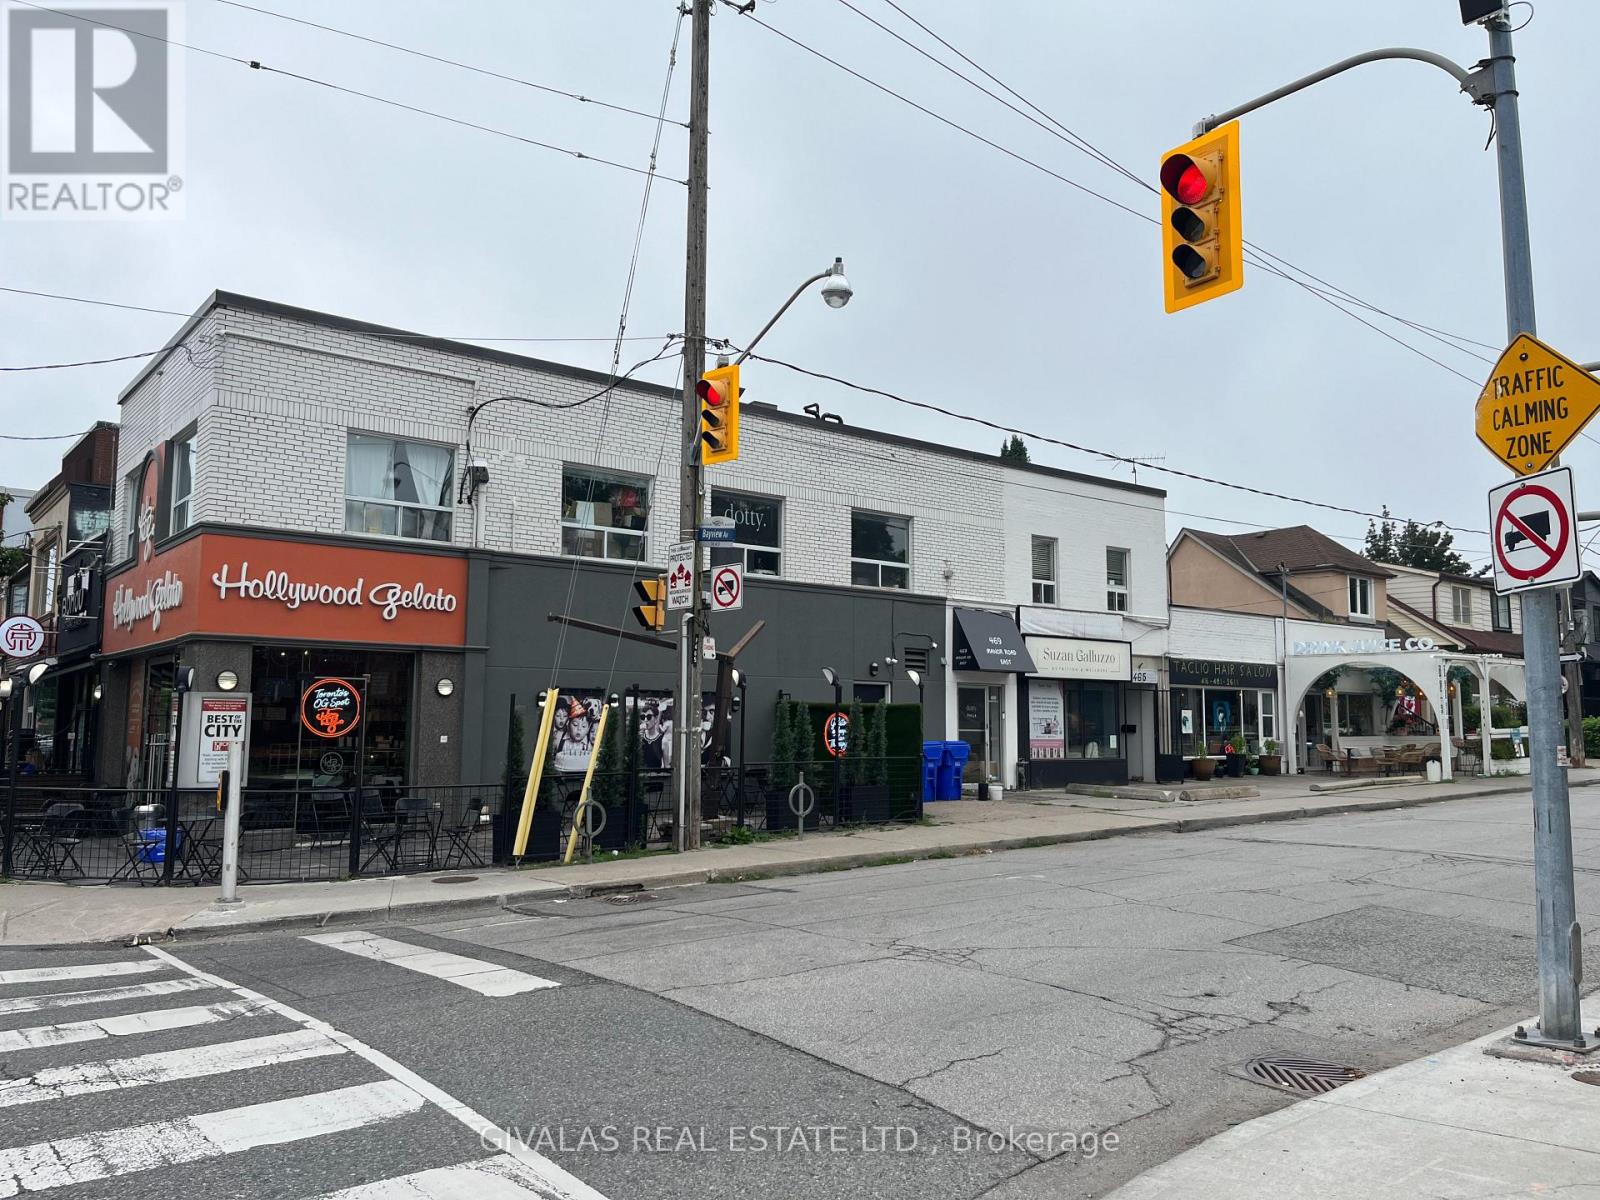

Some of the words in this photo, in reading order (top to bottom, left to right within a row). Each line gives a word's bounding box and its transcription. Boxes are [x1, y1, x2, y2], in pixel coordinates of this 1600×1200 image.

[1493, 365, 1564, 400] TRAFFIC
[1493, 396, 1568, 431] CALMING
[1506, 431, 1553, 460] ZONE
[702, 529, 722, 540] Bayview
[670, 552, 693, 562] PROTECTED
[212, 561, 364, 609] Hollywood
[369, 582, 457, 620] Gelato
[672, 596, 689, 605] WATCH
[988, 636, 1002, 645] 469
[1405, 637, 1439, 651] CO.
[1043, 647, 1074, 661] Suzan
[1076, 649, 1116, 664] Galluzzo
[1133, 672, 1147, 682] 465
[1214, 664, 1235, 676] HAIR
[1239, 664, 1273, 678] SALON
[314, 688, 349, 698] Toronto's
[313, 698, 330, 708] OG
[329, 697, 350, 707] Spot
[207, 714, 234, 723] BEST
[204, 724, 242, 738] CITY
